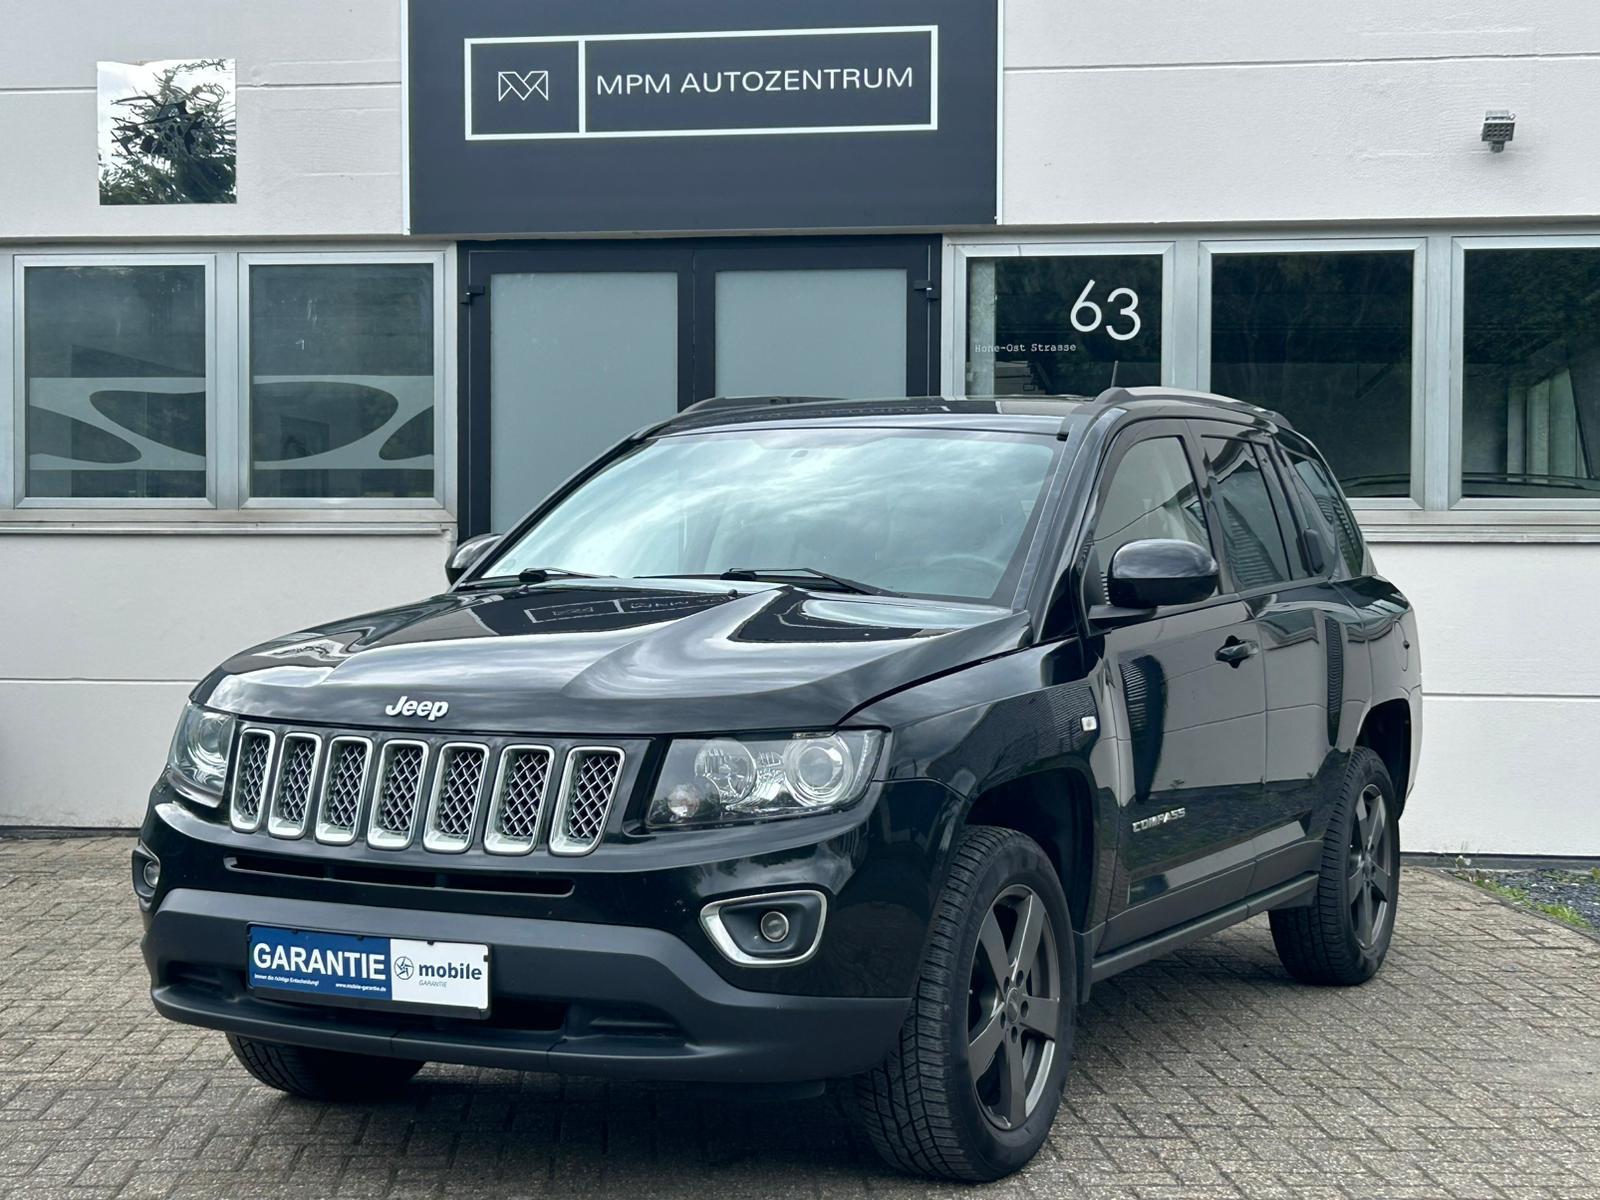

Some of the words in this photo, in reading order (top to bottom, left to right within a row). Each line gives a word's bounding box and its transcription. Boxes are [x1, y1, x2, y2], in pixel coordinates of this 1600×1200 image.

[596, 73, 671, 95] MPM
[680, 67, 913, 93] AUTOZENTRUM
[1070, 279, 1141, 341] 63
[1031, 343, 1077, 352] Strasse
[385, 695, 449, 721] Jeep
[1131, 807, 1186, 832] COMPASS
[253, 943, 387, 980] GARANTIE
[419, 962, 482, 980] mobile
[418, 979, 447, 988] GARANTIE
